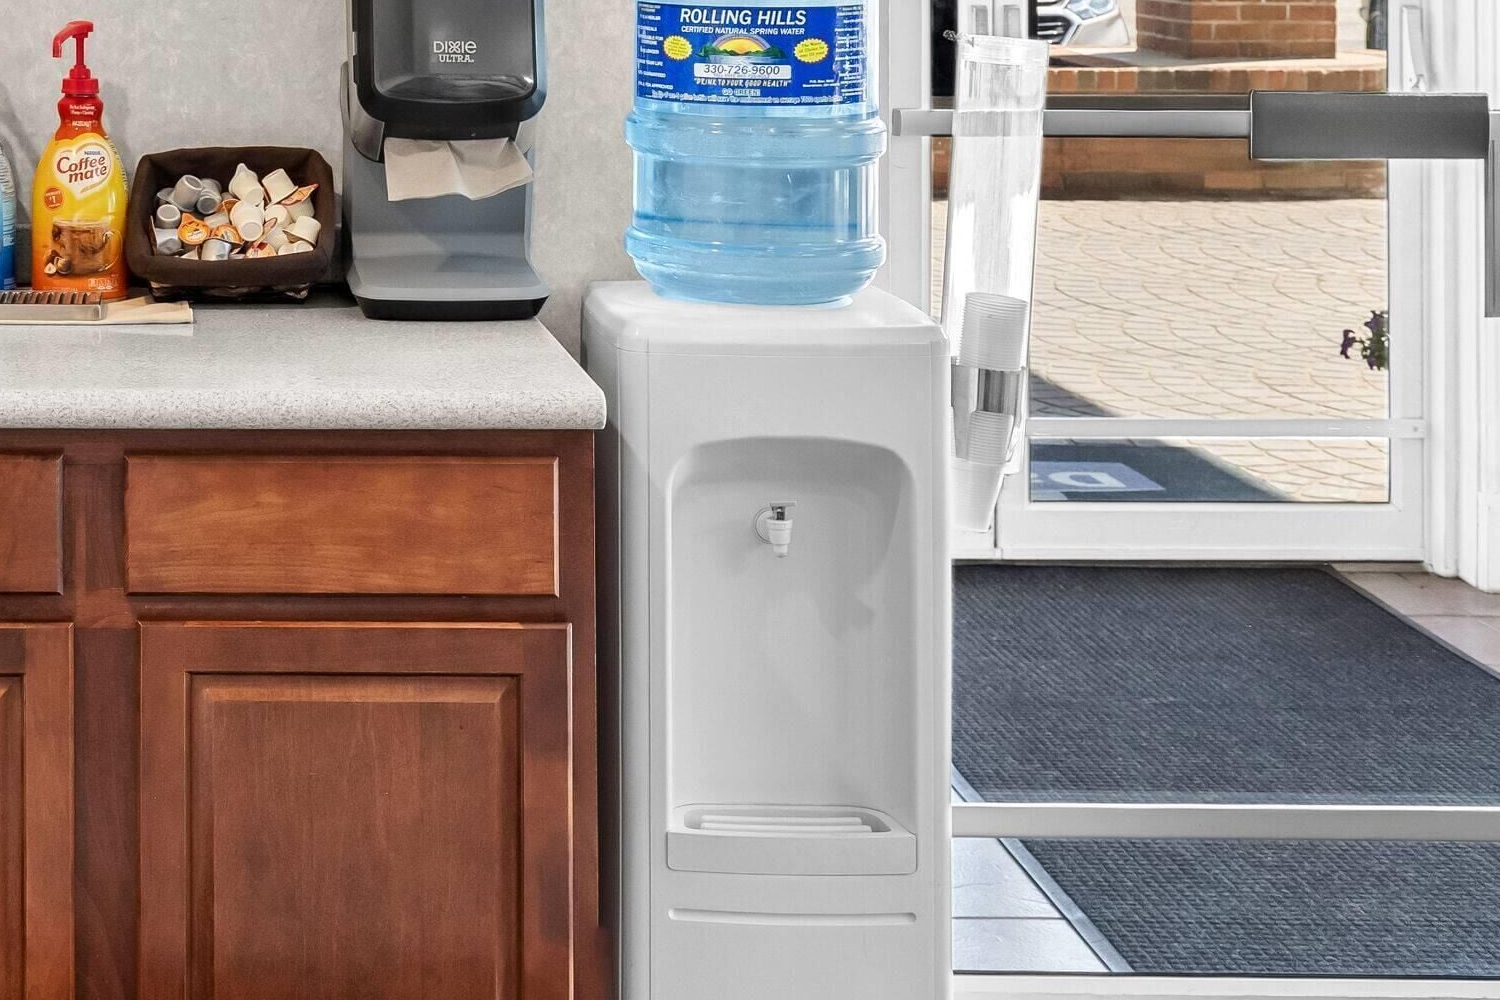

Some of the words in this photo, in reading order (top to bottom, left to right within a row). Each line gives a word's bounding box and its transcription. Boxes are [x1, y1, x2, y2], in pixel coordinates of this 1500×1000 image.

[680, 8, 751, 25] ROLLING
[757, 10, 806, 26] HILLS
[681, 26, 714, 34] CERTIFIED
[715, 27, 748, 35] NATURAL
[703, 64, 780, 75] 330-726-9600
[56, 156, 106, 174] Coffee
[68, 165, 107, 184] mate
